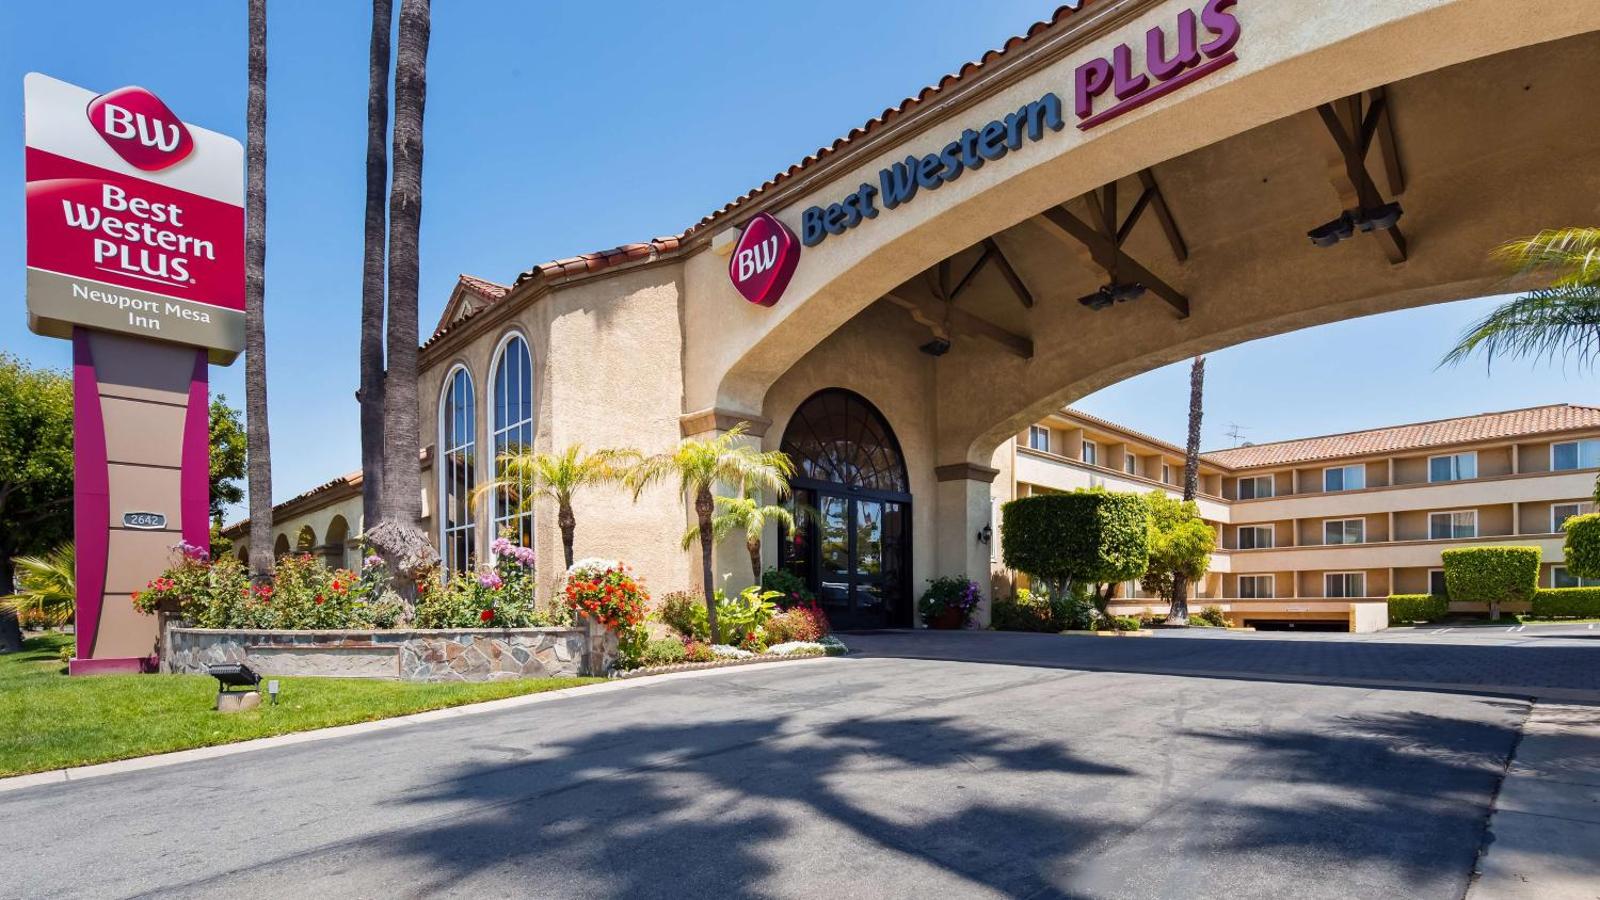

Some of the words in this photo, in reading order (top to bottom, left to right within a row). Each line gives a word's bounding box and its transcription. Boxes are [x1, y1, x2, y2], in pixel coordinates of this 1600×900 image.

[104, 103, 181, 152] BW
[802, 182, 879, 247] Best
[879, 92, 1065, 210] Western
[1075, 0, 1241, 119] PLUS
[102, 183, 183, 227] Best
[62, 199, 215, 260] Western
[738, 234, 779, 282] BW
[72, 283, 160, 313] Newport
[165, 302, 211, 323] Mesa
[128, 312, 161, 330] Inn
[131, 514, 159, 525] 2642
